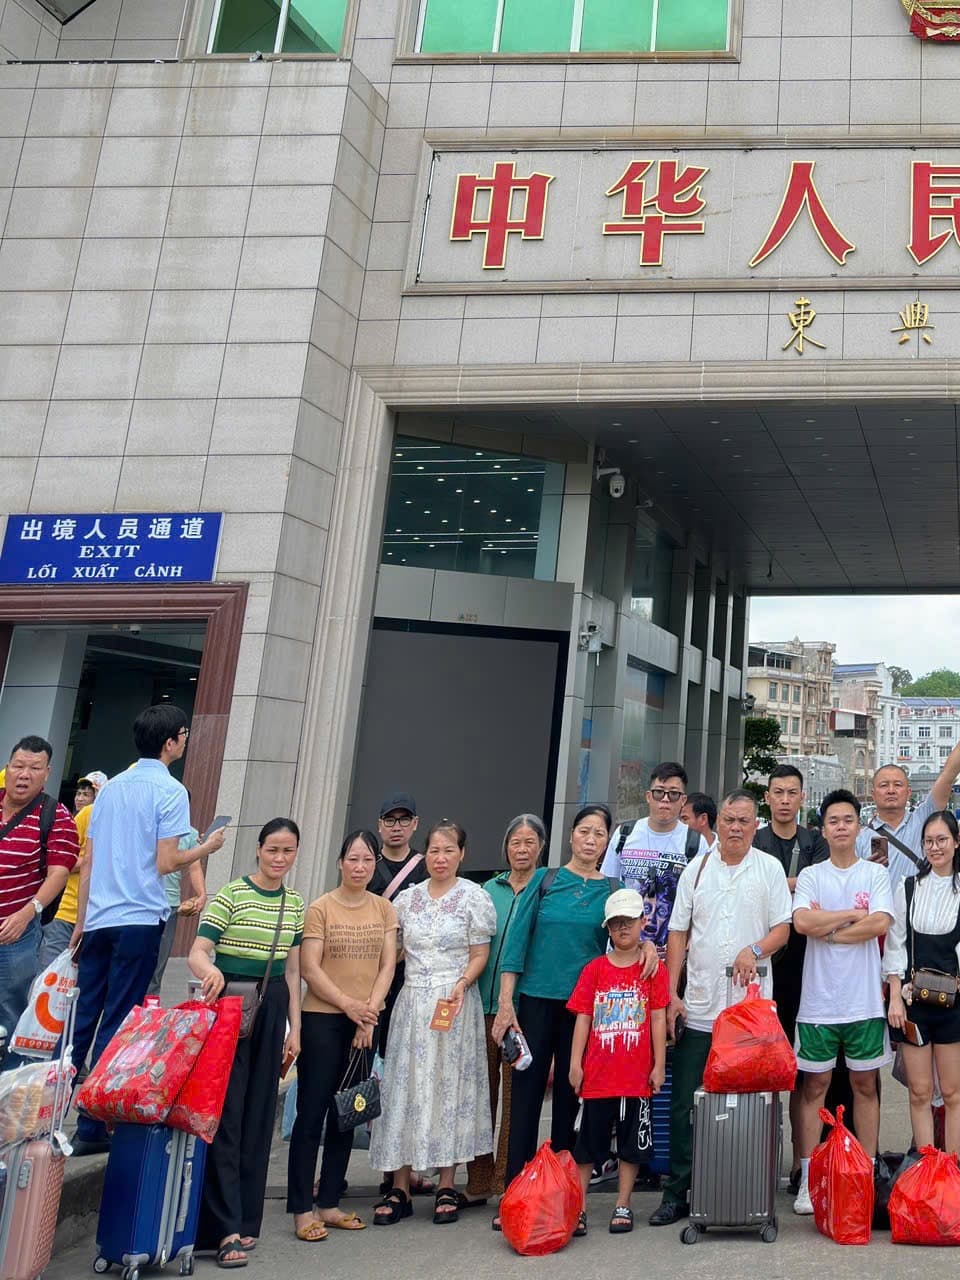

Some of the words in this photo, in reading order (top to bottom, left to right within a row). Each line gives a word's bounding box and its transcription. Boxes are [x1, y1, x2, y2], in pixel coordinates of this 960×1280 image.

[20, 517, 206, 541] 出境人员通道
[78, 545, 141, 559] EXIT
[27, 563, 58, 579] LỐI
[72, 563, 119, 579] XUẤT
[134, 562, 184, 578] CẢNH
